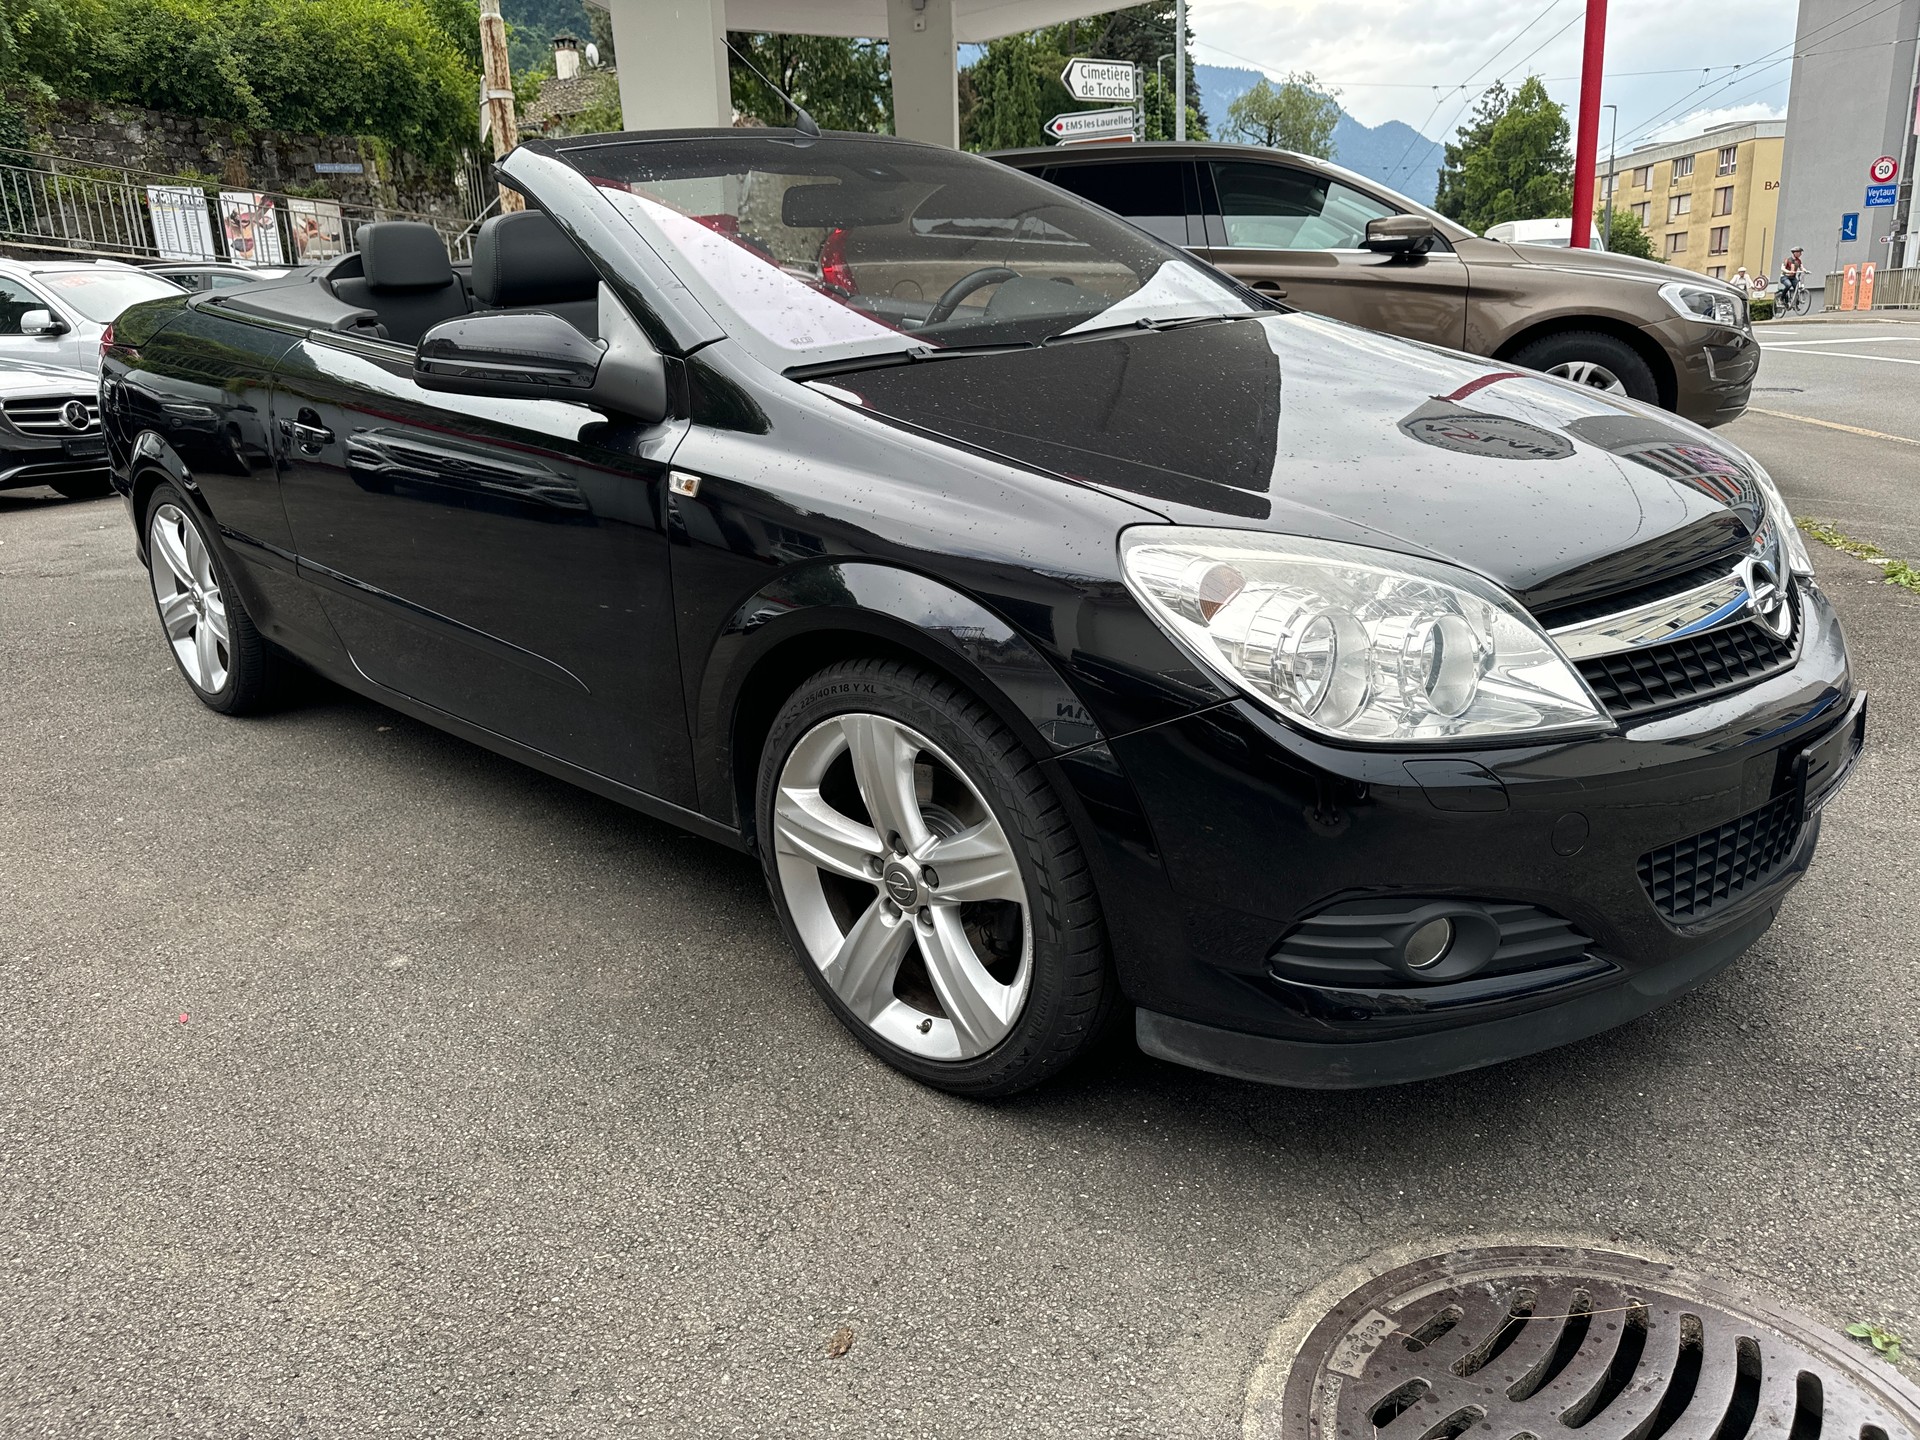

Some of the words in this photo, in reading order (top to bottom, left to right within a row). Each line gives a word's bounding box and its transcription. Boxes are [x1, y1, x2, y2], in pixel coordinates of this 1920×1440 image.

[1080, 64, 1130, 81] Cimetière
[1081, 81, 1094, 96] de
[1097, 82, 1130, 97] Troche
[1066, 120, 1084, 131] EMS
[1084, 119, 1095, 129] les
[1096, 115, 1132, 127] Laurelles
[1878, 165, 1890, 175] 50
[1868, 188, 1895, 199] Veytaux
[1870, 197, 1891, 205] (Chillon)
[800, 687, 830, 709] 225/40
[853, 683, 860, 692] Y
[863, 683, 876, 694] XL
